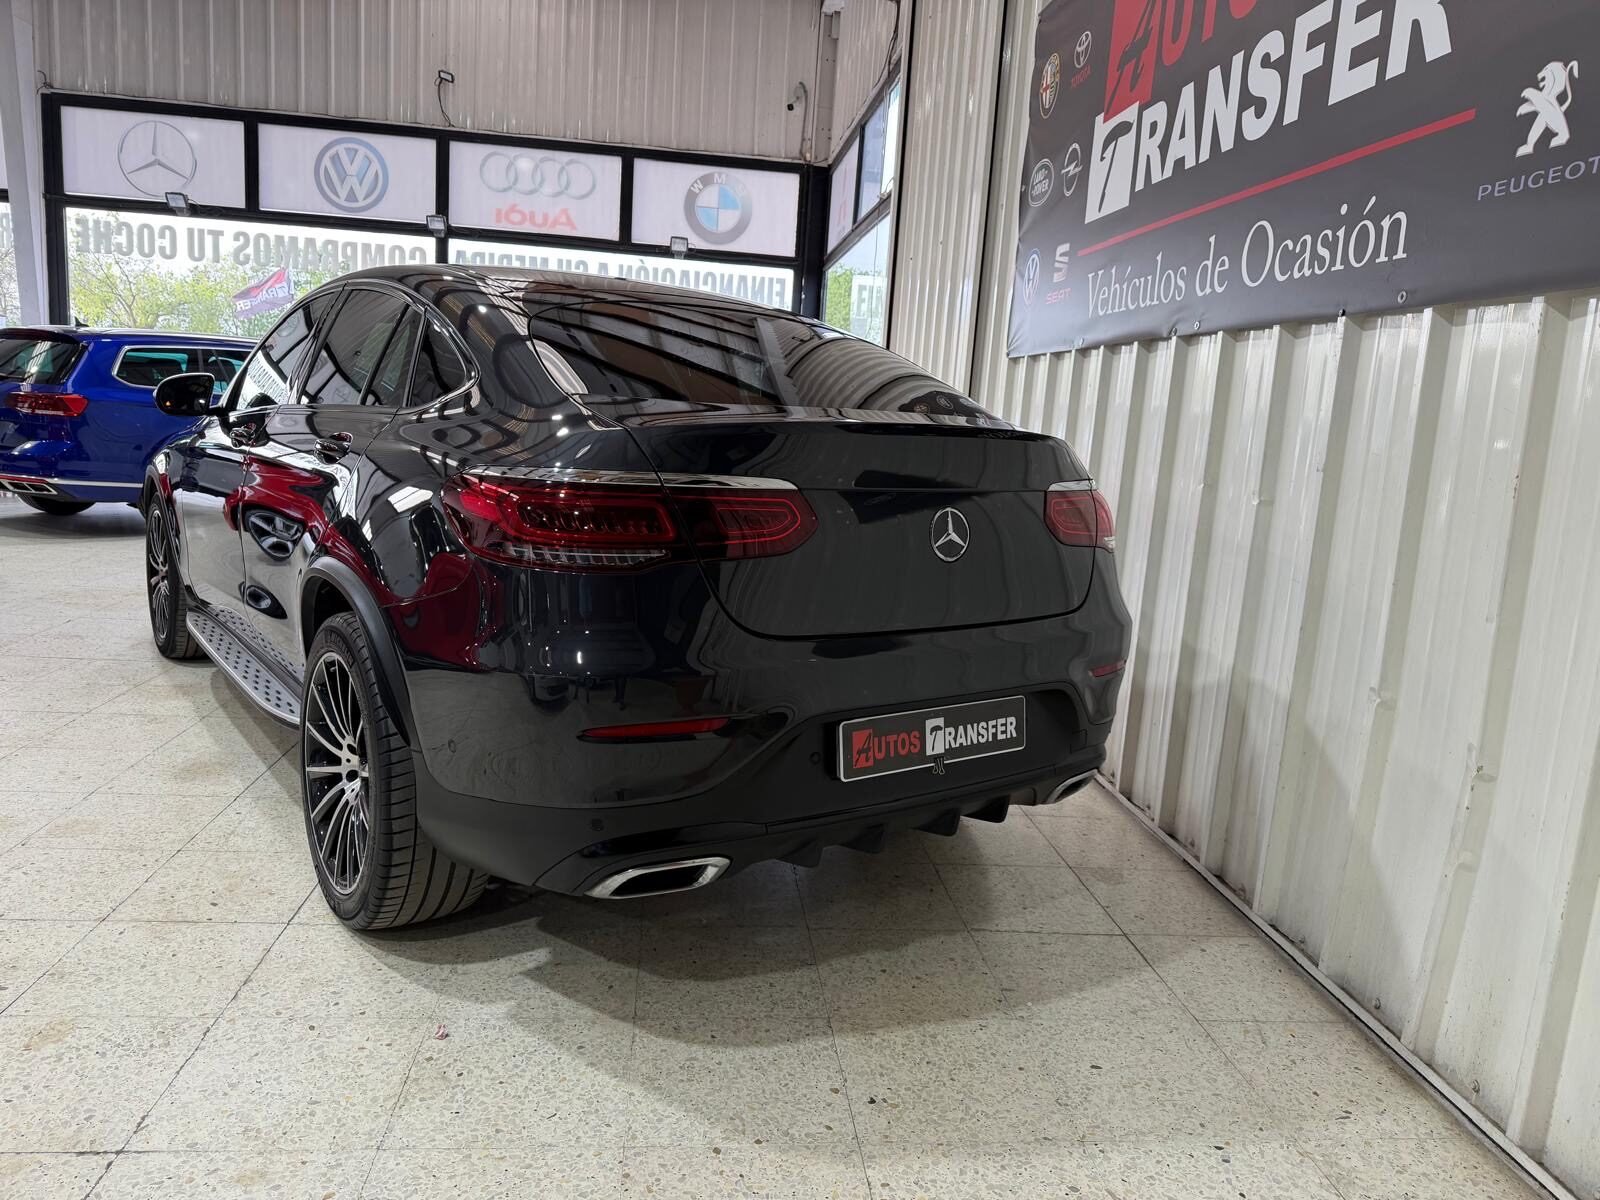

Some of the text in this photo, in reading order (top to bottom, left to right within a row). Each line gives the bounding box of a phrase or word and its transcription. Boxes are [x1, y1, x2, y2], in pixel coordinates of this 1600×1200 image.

[1085, 0, 1452, 224] TRANSFER
[1477, 155, 1600, 201] PEUGEOT
[1087, 195, 1408, 318] Vehículos de Ocasión
[852, 716, 1017, 769] AUTOS TRANSFER
